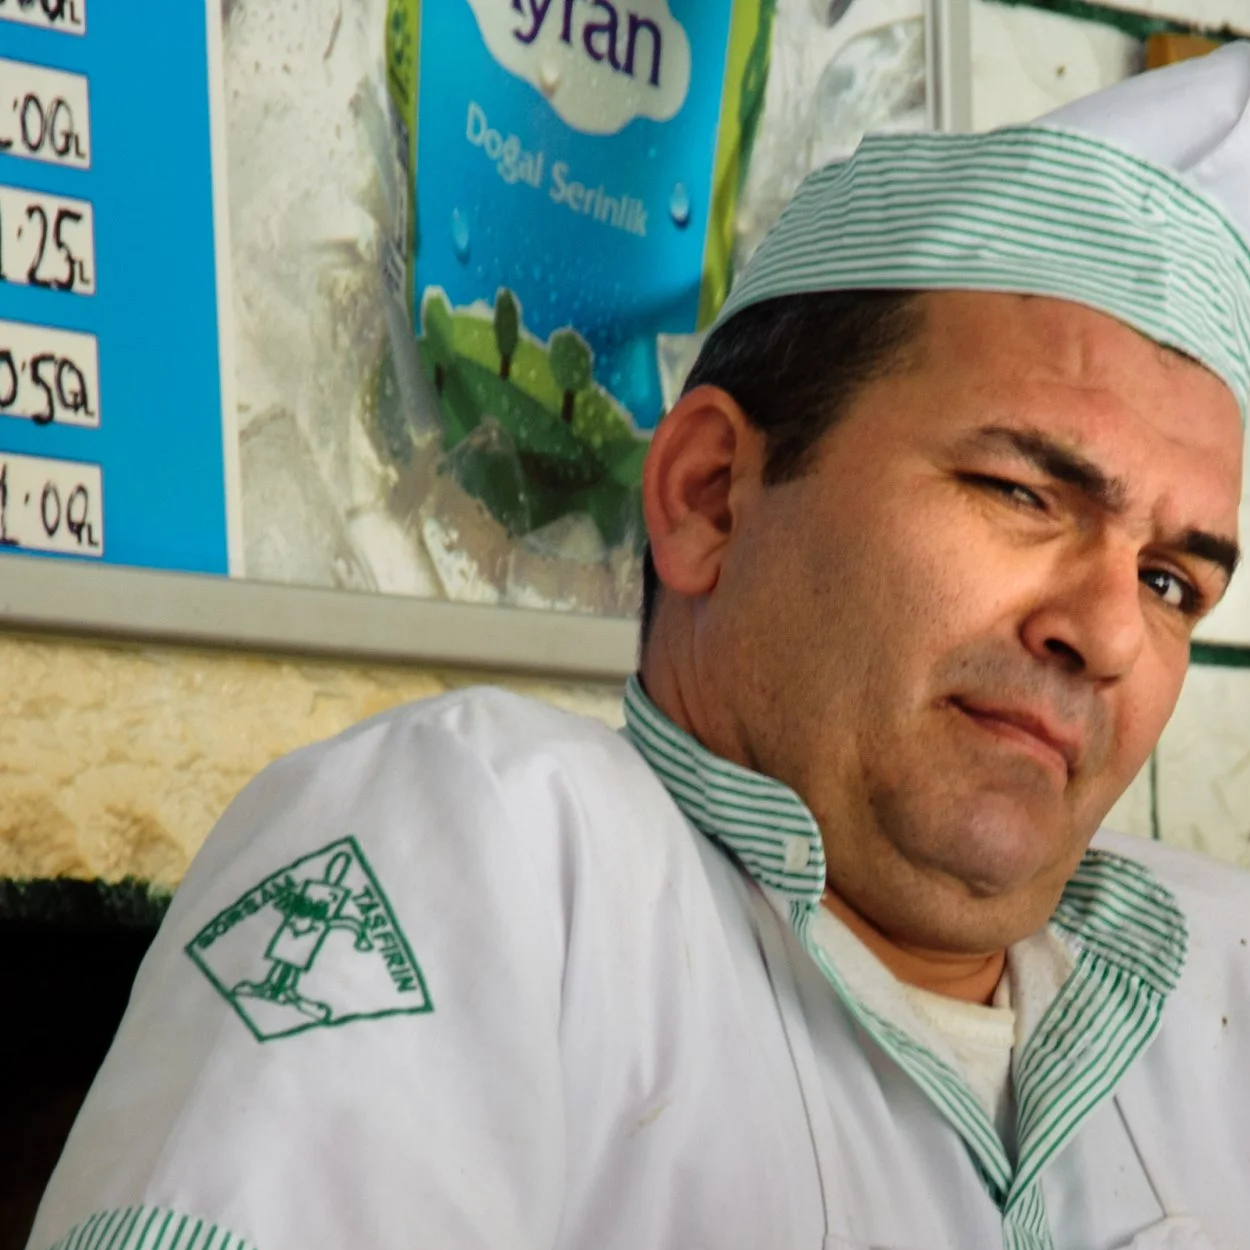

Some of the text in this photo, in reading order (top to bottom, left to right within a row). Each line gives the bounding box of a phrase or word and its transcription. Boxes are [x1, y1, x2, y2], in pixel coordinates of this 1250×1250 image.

[511, 0, 663, 87] yran
[465, 99, 648, 238] Doğal Serinlik
